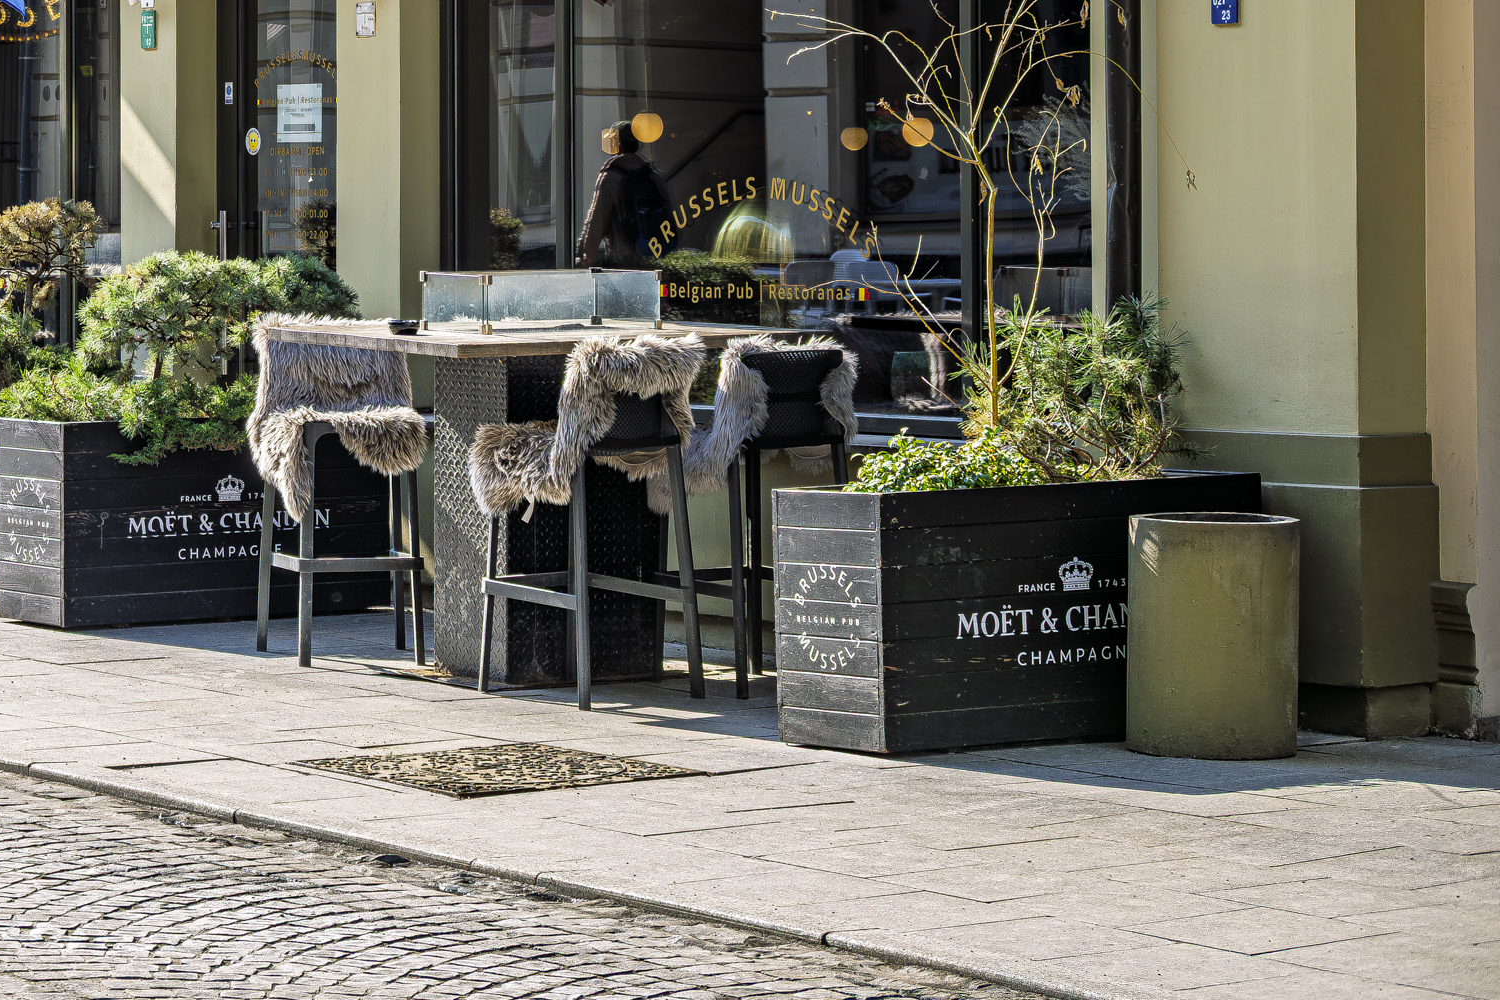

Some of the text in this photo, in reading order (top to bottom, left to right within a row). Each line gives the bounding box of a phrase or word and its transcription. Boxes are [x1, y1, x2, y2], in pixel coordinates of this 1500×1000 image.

[1221, 10, 1231, 20] 23
[254, 50, 337, 88] BRUSSELS MUSSEL
[262, 96, 332, 107] Belgian Pub Restoranas
[270, 146, 325, 157] DIRBAME OPEN
[648, 176, 876, 259] BRUSSELS MUSSELS
[669, 283, 852, 304] Belgian Pub Restoranas
[180, 494, 212, 502] FRANCE
[128, 508, 331, 538] MOËT & CHANN
[178, 543, 282, 560] CHAMPAGE
[794, 565, 861, 608] BRUSSELS
[1018, 578, 1126, 593] FRANCE 1743
[796, 614, 860, 627] BELGIAN PUB
[956, 604, 1033, 640] MOËT
[1040, 606, 1059, 634] &
[798, 631, 860, 671] MUSSELS
[1017, 644, 1126, 667] CHAMPAGN
